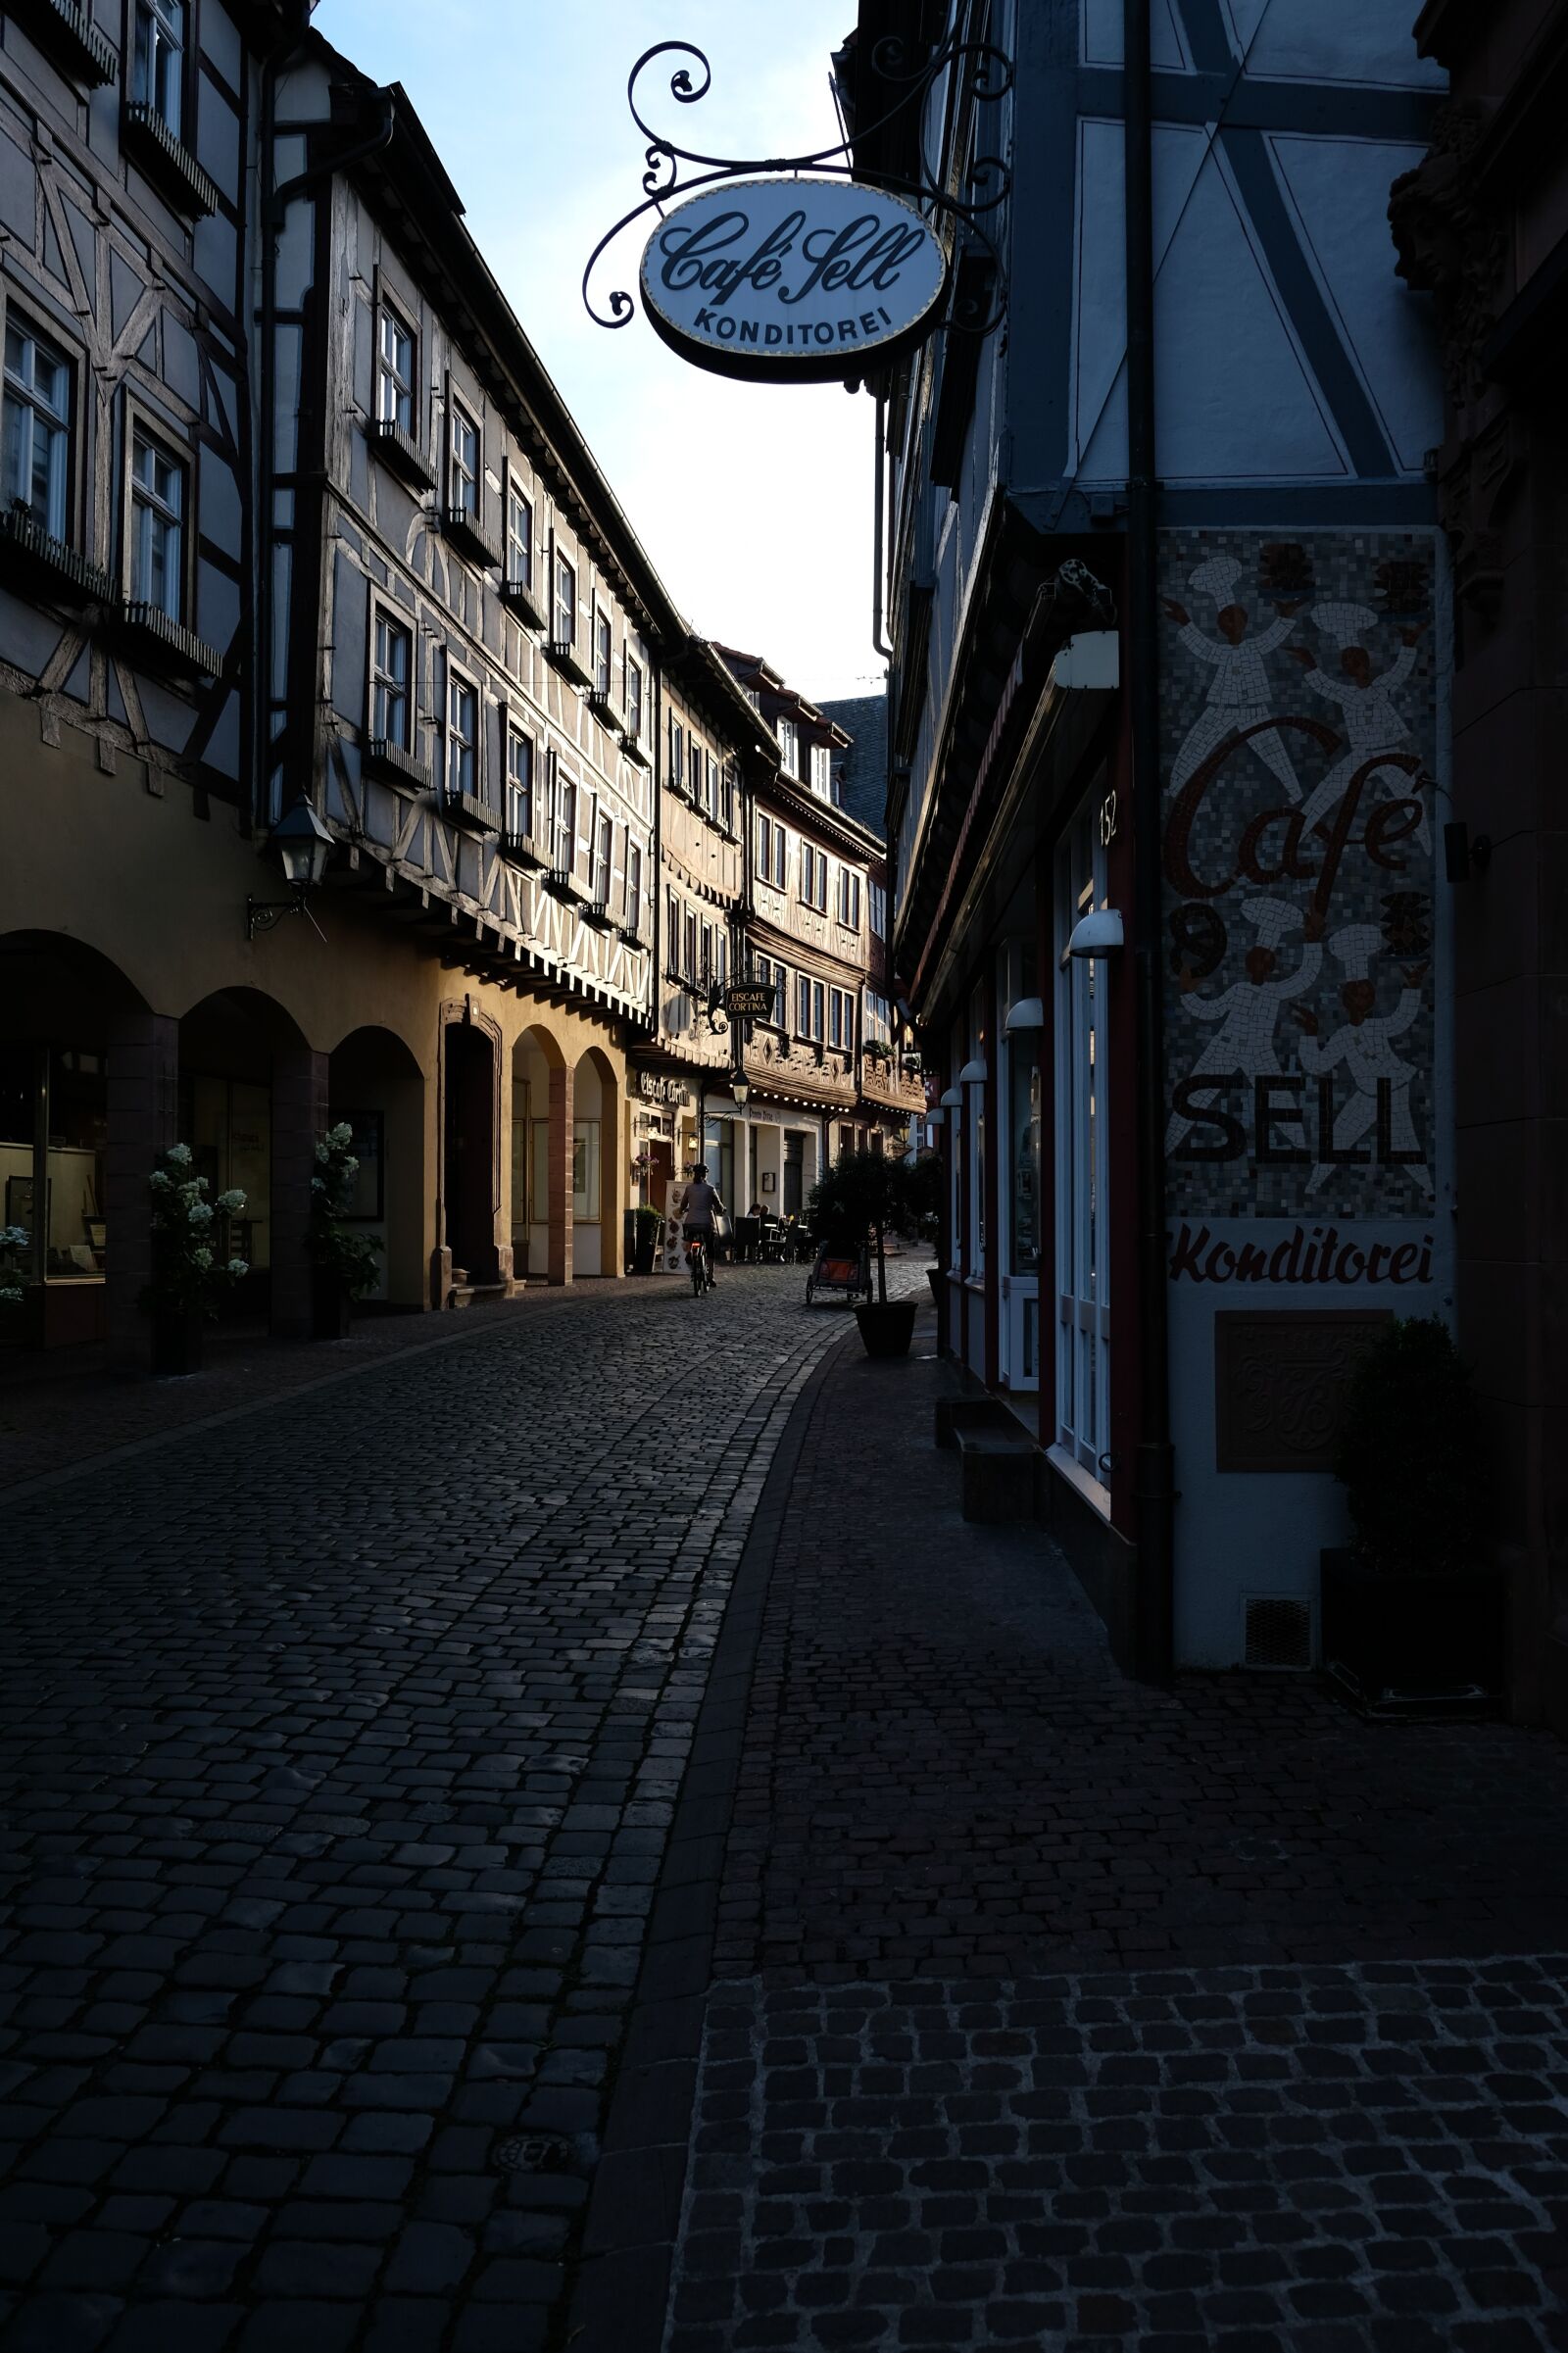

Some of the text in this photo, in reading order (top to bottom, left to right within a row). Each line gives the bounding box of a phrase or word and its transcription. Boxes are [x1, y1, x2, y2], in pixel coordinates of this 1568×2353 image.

[660, 211, 925, 305] Café Sell
[694, 308, 892, 345] KONDITOREI
[1099, 789, 1117, 846] 152
[728, 1002, 767, 1012] CORTINA
[1171, 1073, 1428, 1164] SELL
[1166, 1222, 1434, 1285] Konditorei
